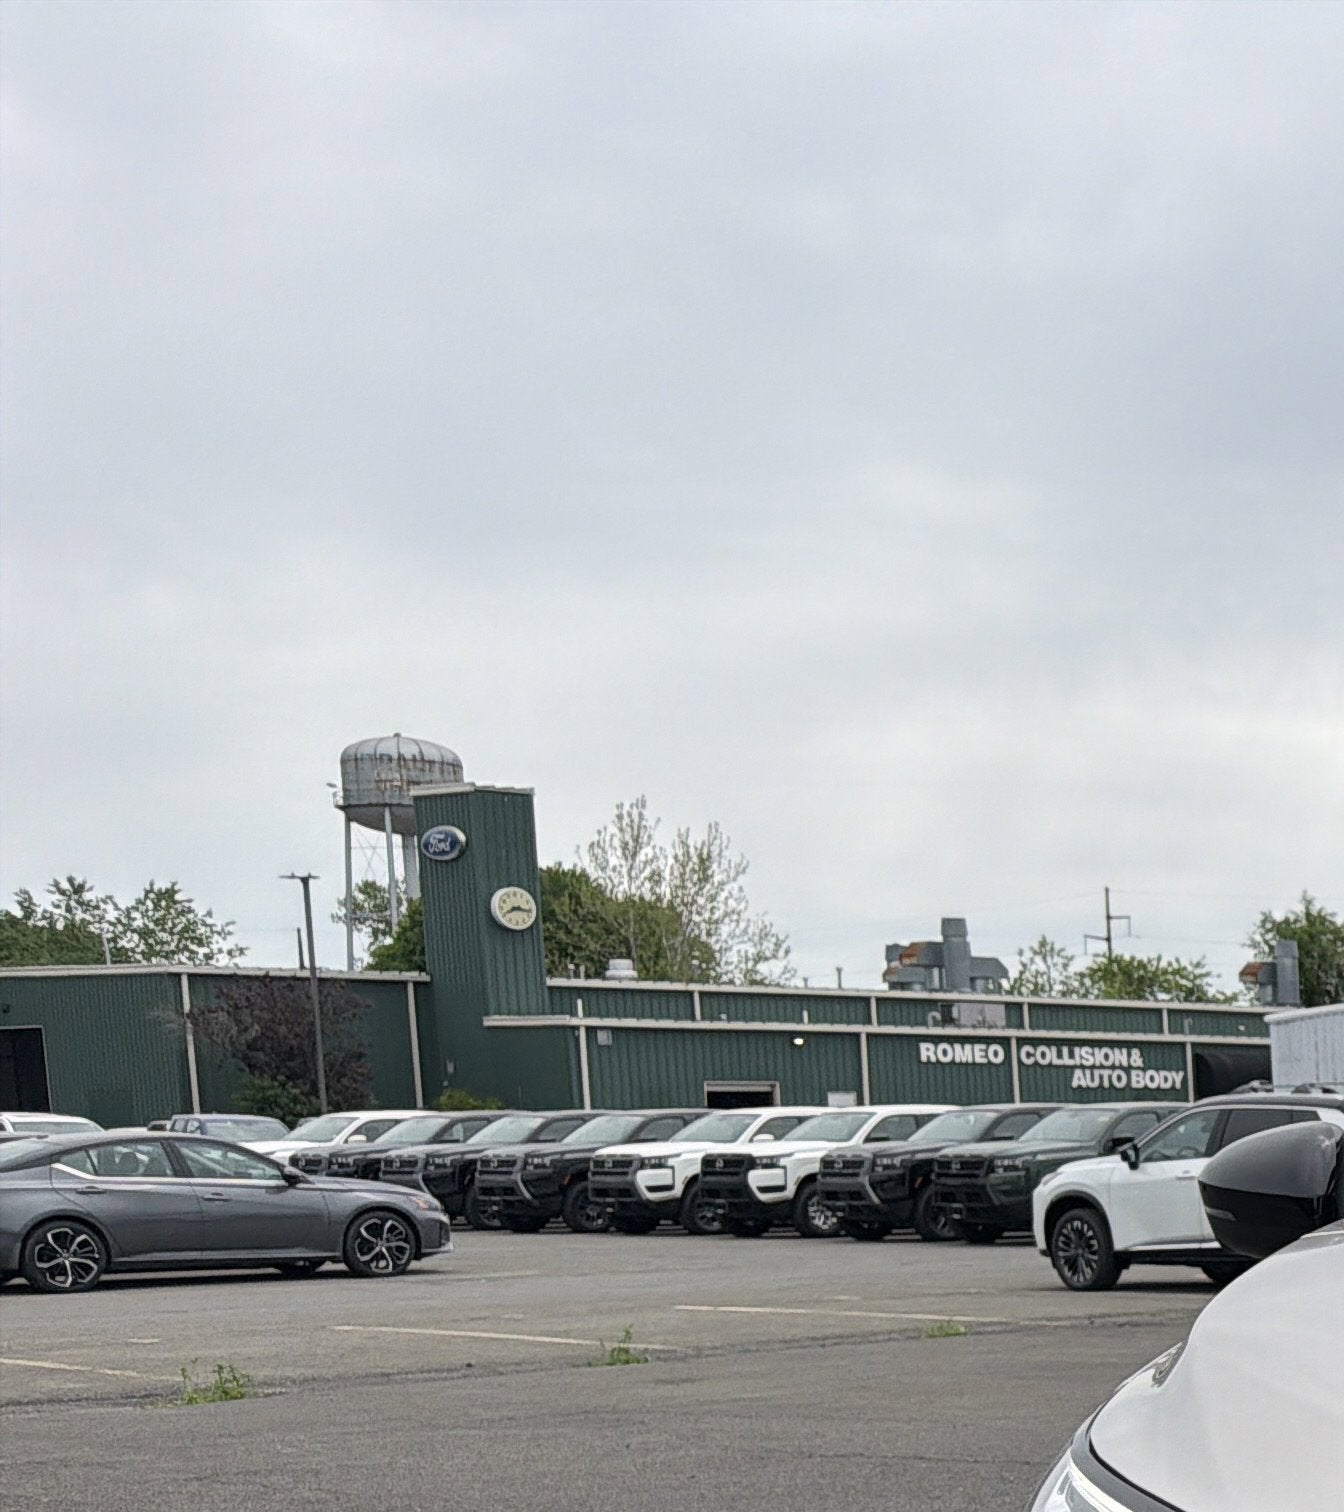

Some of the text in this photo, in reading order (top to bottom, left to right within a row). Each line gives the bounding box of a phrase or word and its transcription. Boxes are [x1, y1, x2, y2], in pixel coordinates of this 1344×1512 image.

[919, 1042, 1005, 1064] ROMEO
[1071, 1069, 1184, 1090] AUTO BODY
